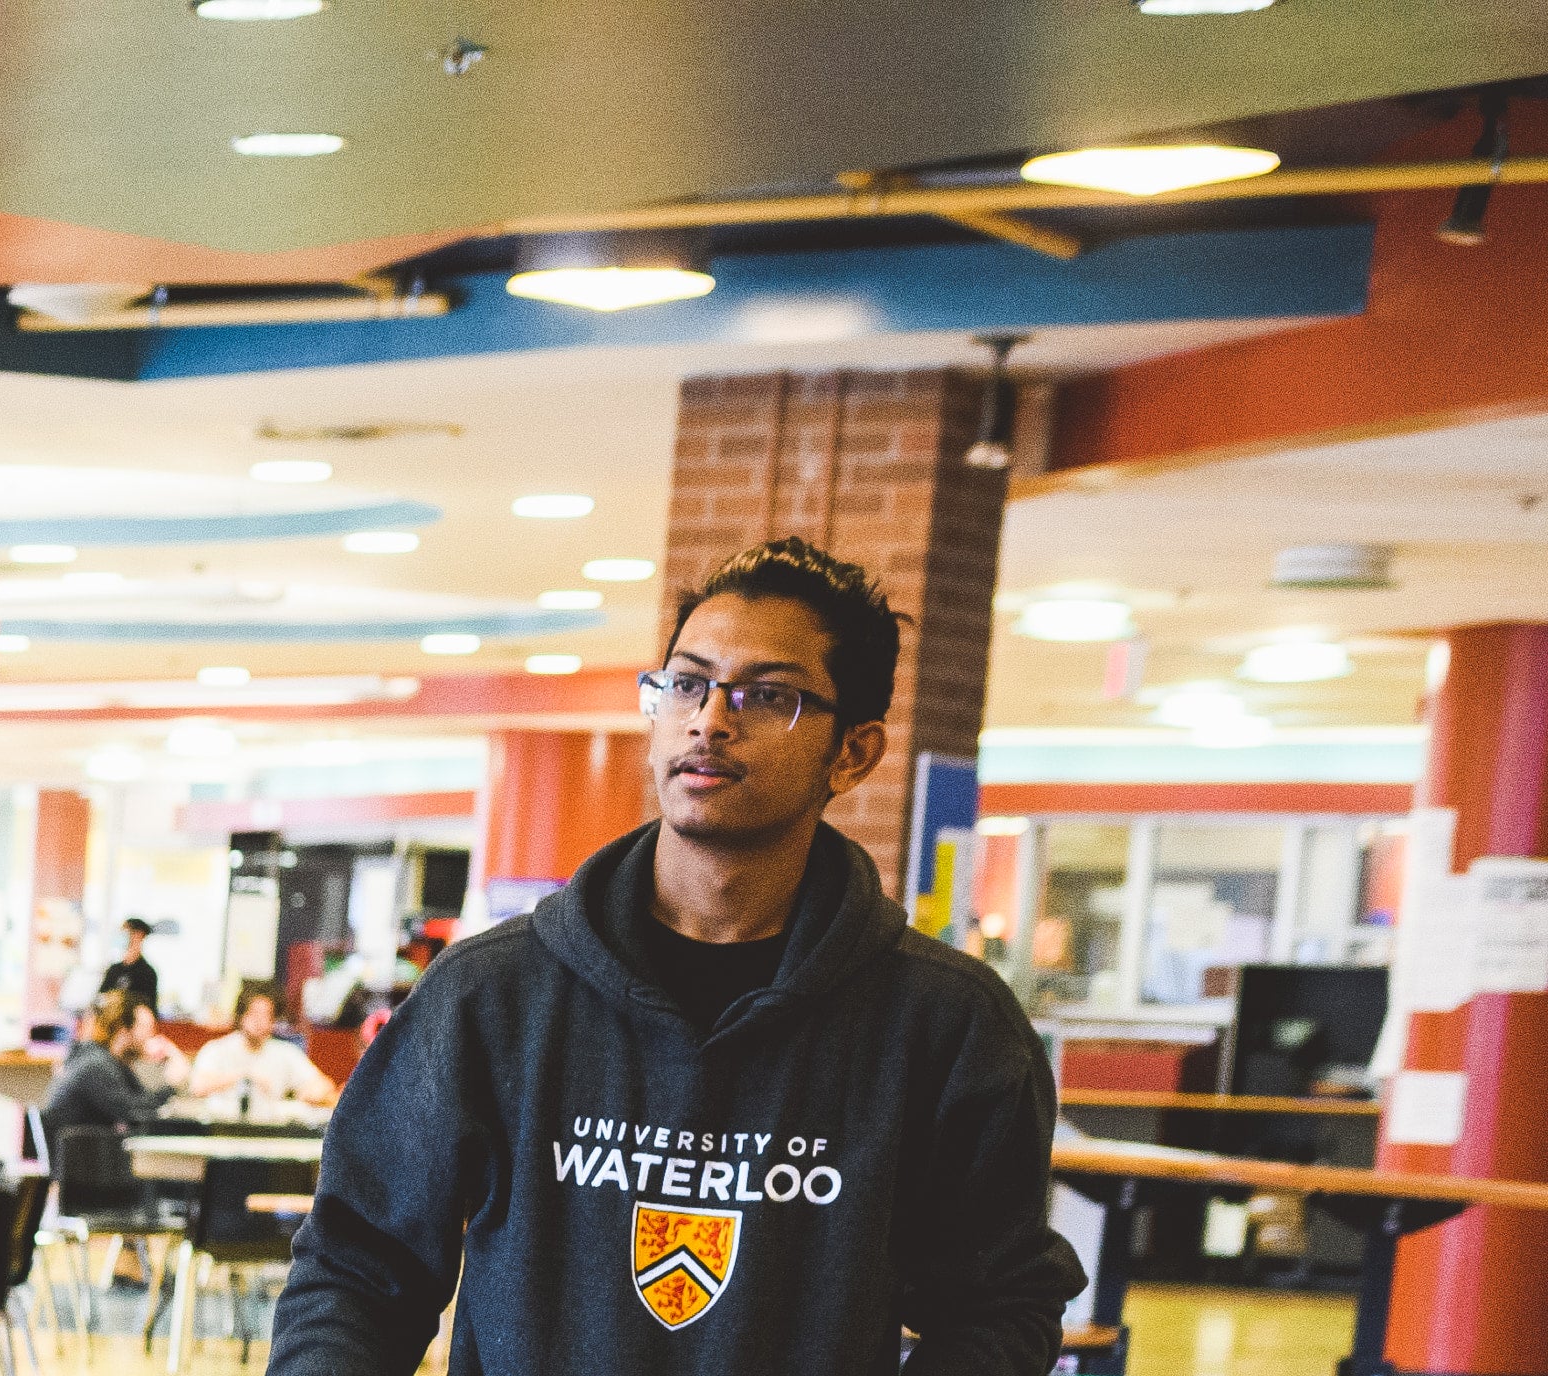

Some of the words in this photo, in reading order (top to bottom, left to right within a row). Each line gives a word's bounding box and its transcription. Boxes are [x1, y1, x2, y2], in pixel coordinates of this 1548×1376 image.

[573, 1115, 772, 1155] UNIVERSITY
[787, 1136, 827, 1158] OF
[553, 1139, 843, 1205] WATERLOO
